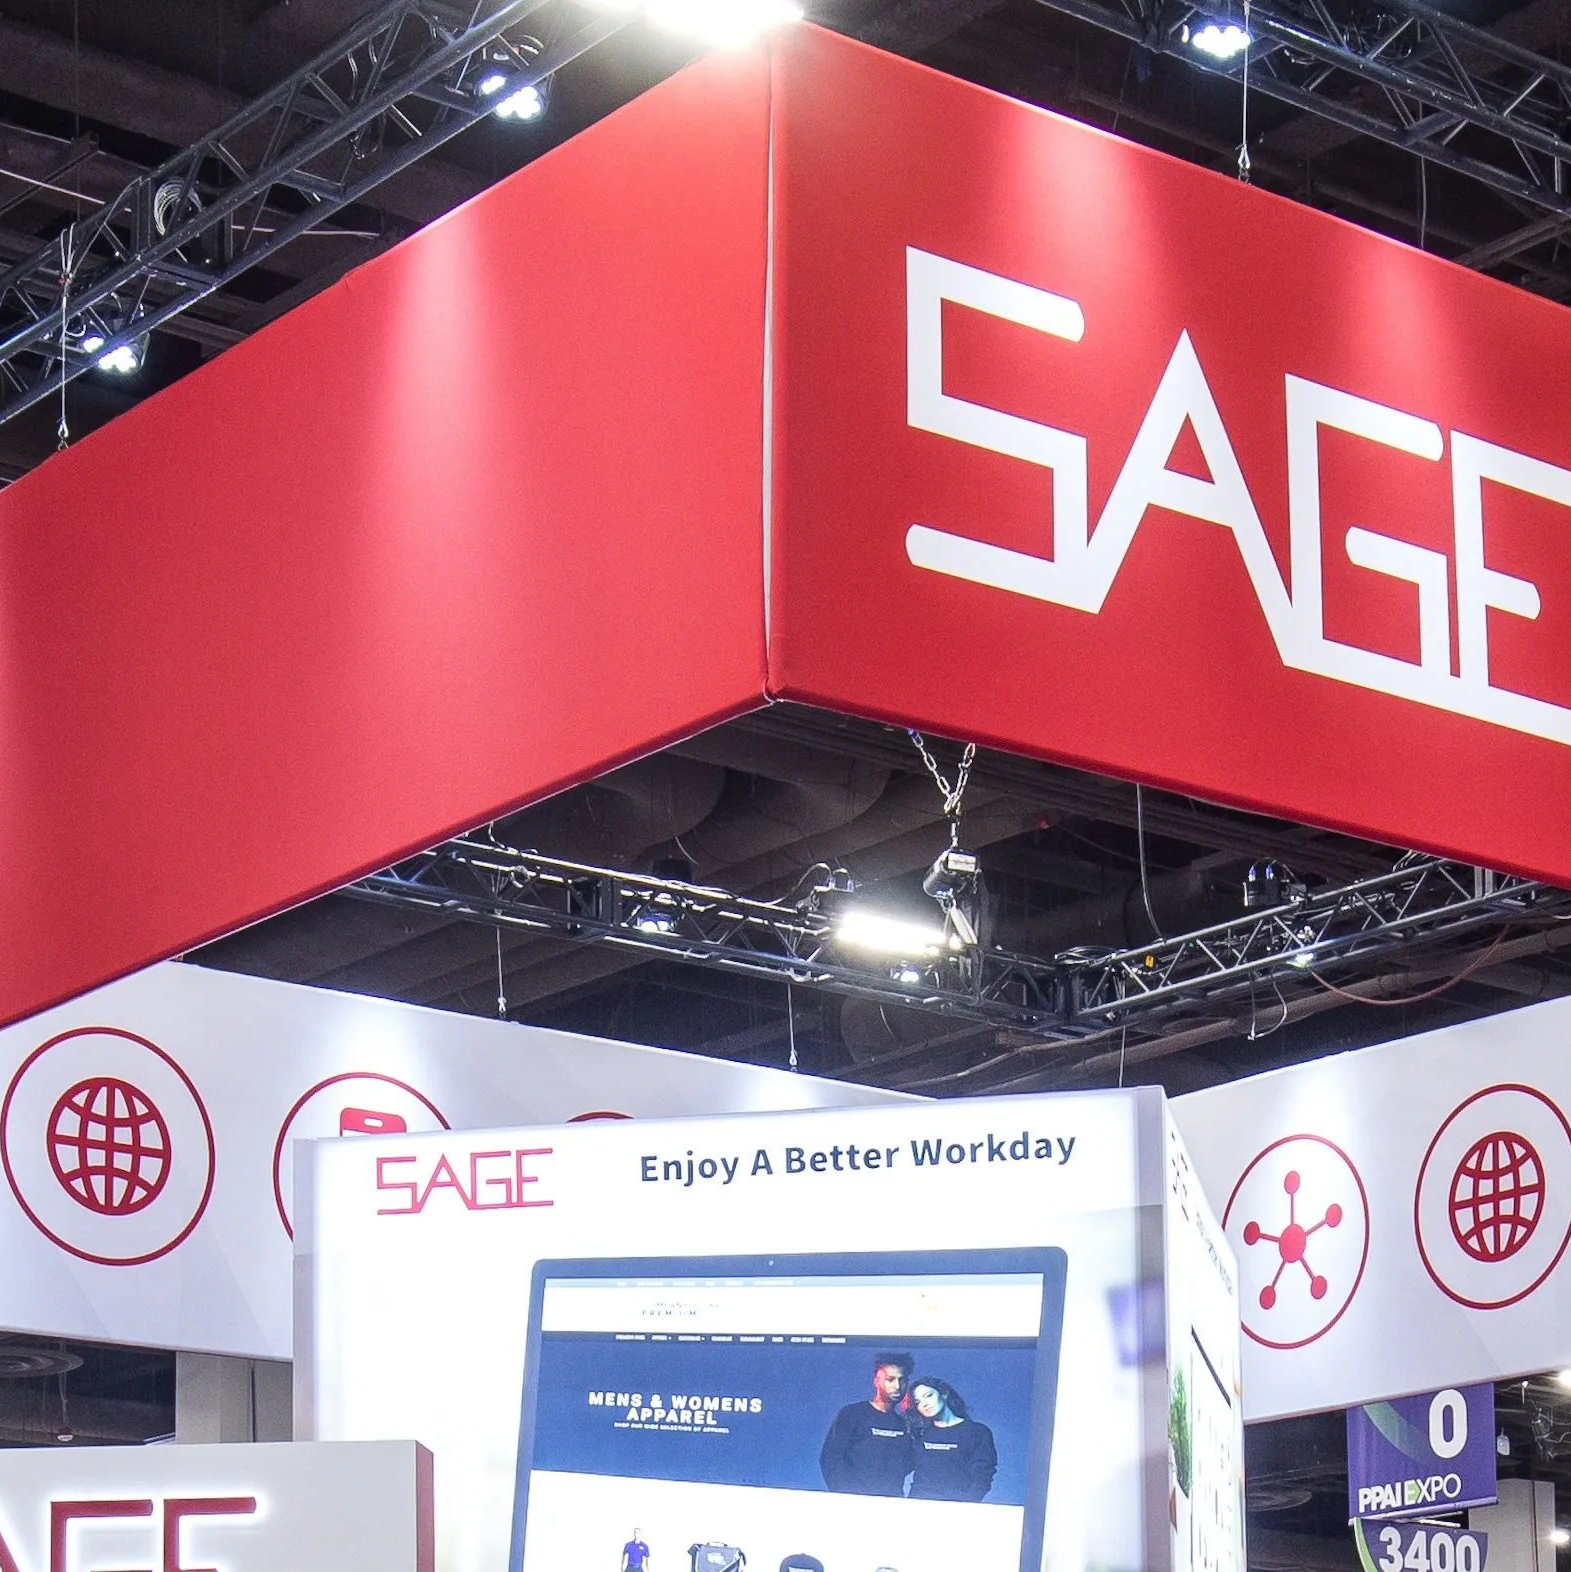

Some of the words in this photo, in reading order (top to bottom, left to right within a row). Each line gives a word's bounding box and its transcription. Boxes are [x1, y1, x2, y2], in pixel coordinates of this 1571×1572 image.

[376, 1147, 554, 1216] SAGE
[640, 1153, 736, 1188] Enjoy
[751, 1151, 774, 1177] A
[784, 1143, 899, 1175] Better
[910, 1130, 1077, 1168] Workday
[588, 1391, 643, 1408] MENS
[650, 1394, 663, 1408] &
[671, 1395, 763, 1413] WOMENS
[626, 1407, 717, 1425] APPAREL
